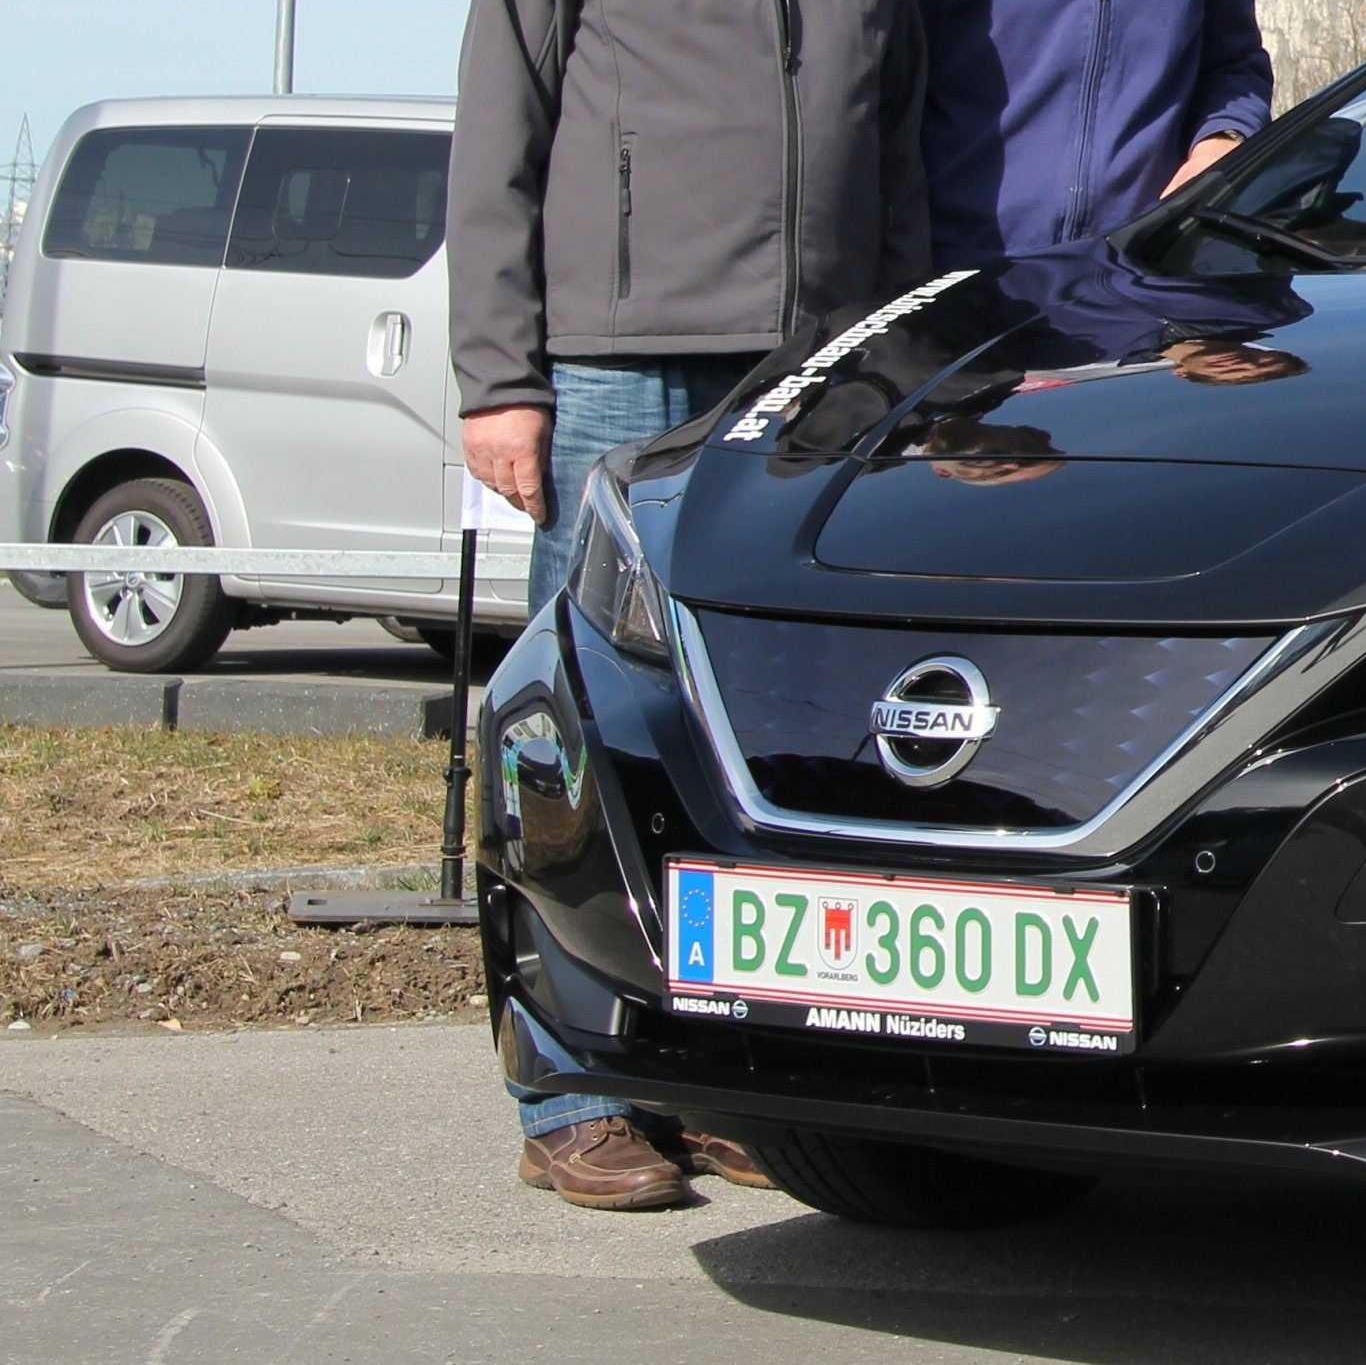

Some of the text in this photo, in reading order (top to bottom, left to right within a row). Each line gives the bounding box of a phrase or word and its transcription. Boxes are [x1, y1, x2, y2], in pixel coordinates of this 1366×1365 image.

[874, 707, 973, 732] NISSAN
[687, 941, 706, 967] A
[732, 889, 1100, 1003] BZ 360 DX
[816, 971, 859, 982] VORARLBERG
[672, 997, 730, 1016] NISSAN
[806, 1007, 966, 1042] AMANN Nüziders
[1049, 1030, 1117, 1051] NISSAN
